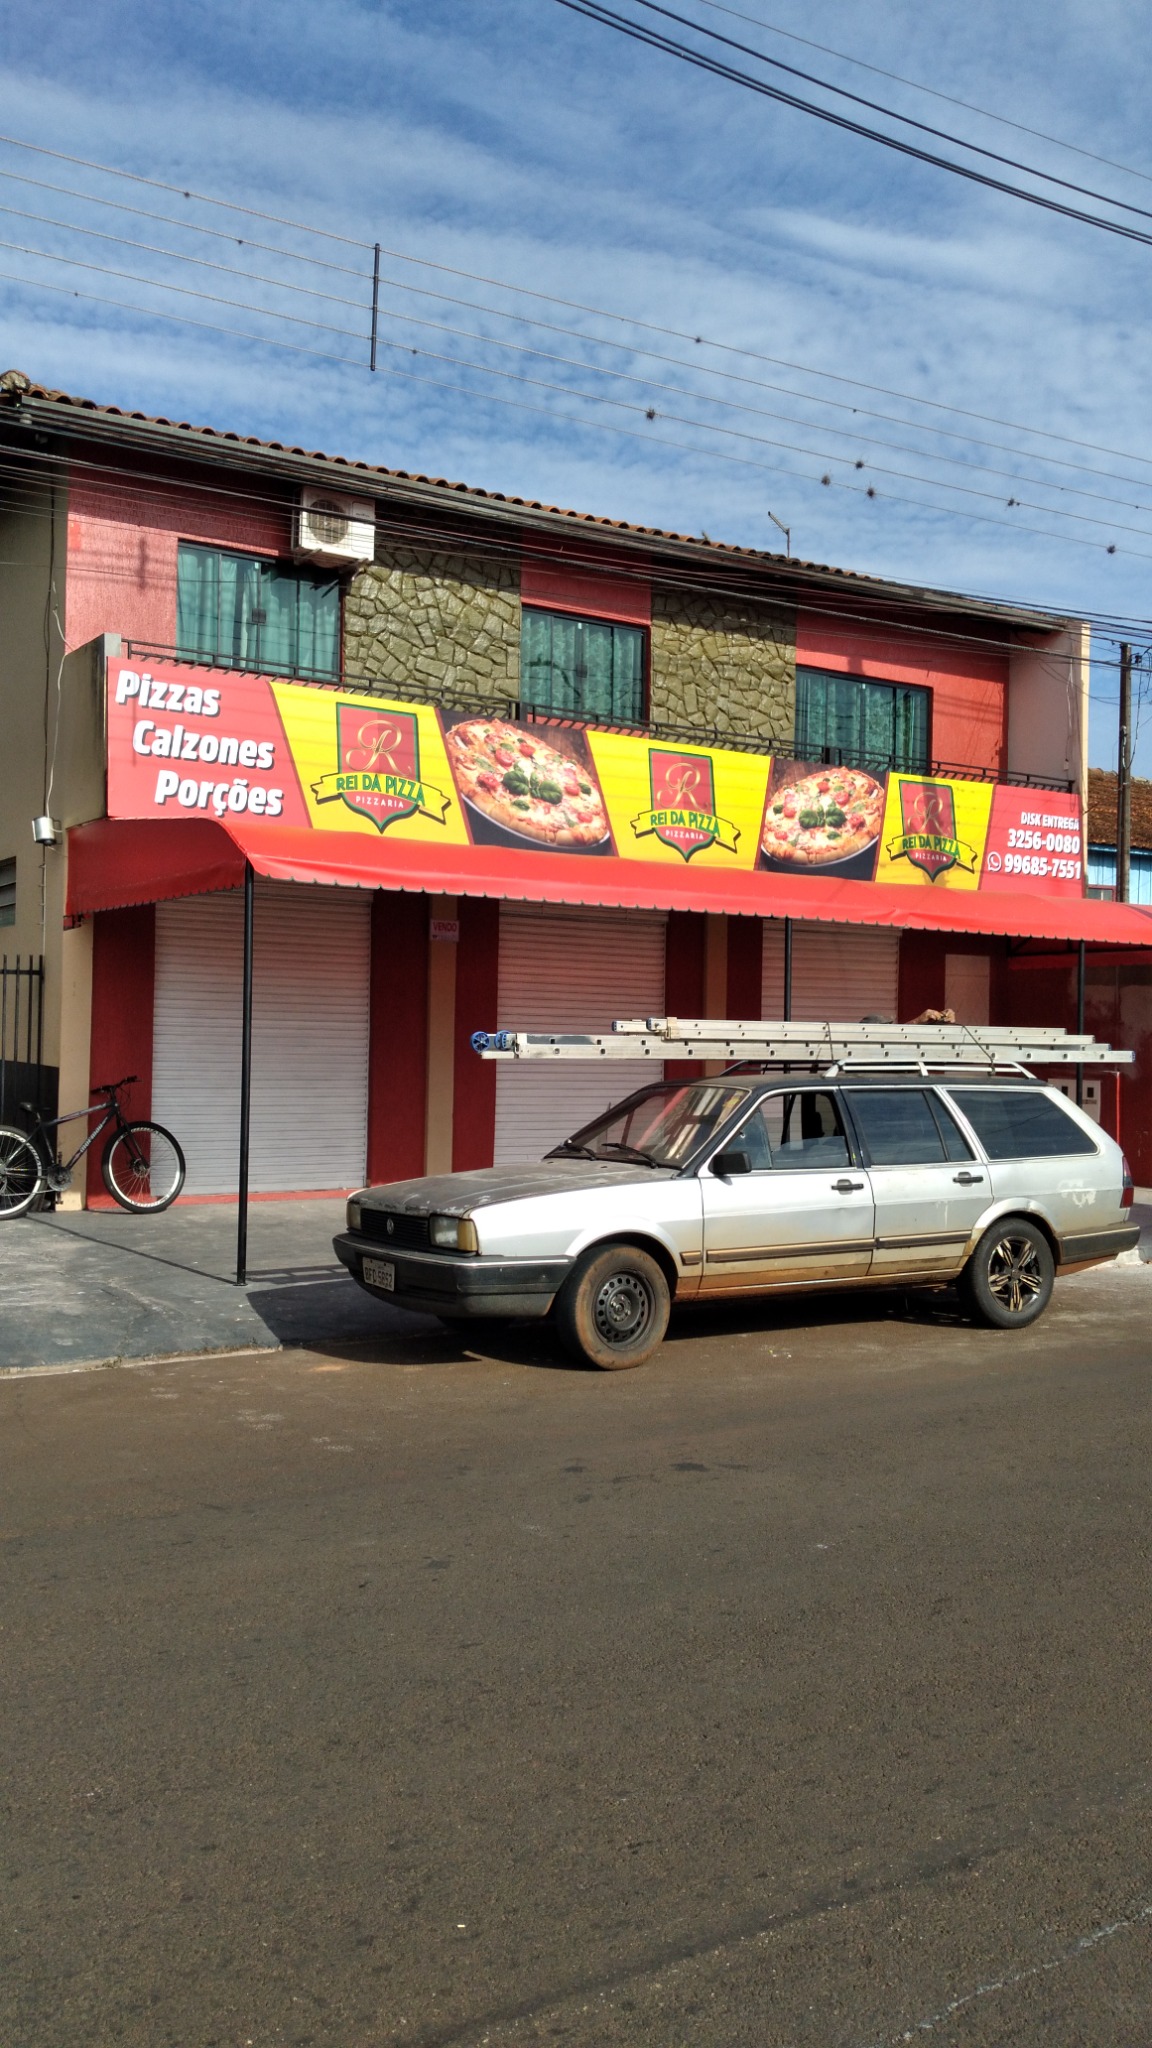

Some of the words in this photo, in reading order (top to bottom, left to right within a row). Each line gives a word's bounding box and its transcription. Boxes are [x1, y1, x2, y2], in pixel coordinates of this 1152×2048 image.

[115, 670, 220, 716] Pizzas
[133, 720, 274, 769] Calzones
[154, 770, 283, 816] Porções
[336, 775, 358, 791] REI
[362, 774, 382, 792] DA
[386, 776, 425, 807] PIZZA
[356, 795, 404, 808] PIZZARIA
[650, 811, 667, 826] REI
[671, 811, 686, 826] DA
[689, 812, 720, 838] PIZZA
[1021, 812, 1041, 827] DISK
[1042, 814, 1080, 831] ENTREGA
[665, 830, 704, 840] PIZZARIA
[902, 836, 917, 849] REI
[919, 835, 932, 849] DA
[934, 836, 961, 859] PIZZA
[1007, 828, 1080, 854] 3256-0080
[915, 852, 947, 862] PIZZARIA
[1004, 853, 1081, 880] 99685-7551
[432, 921, 458, 932] VENDO
